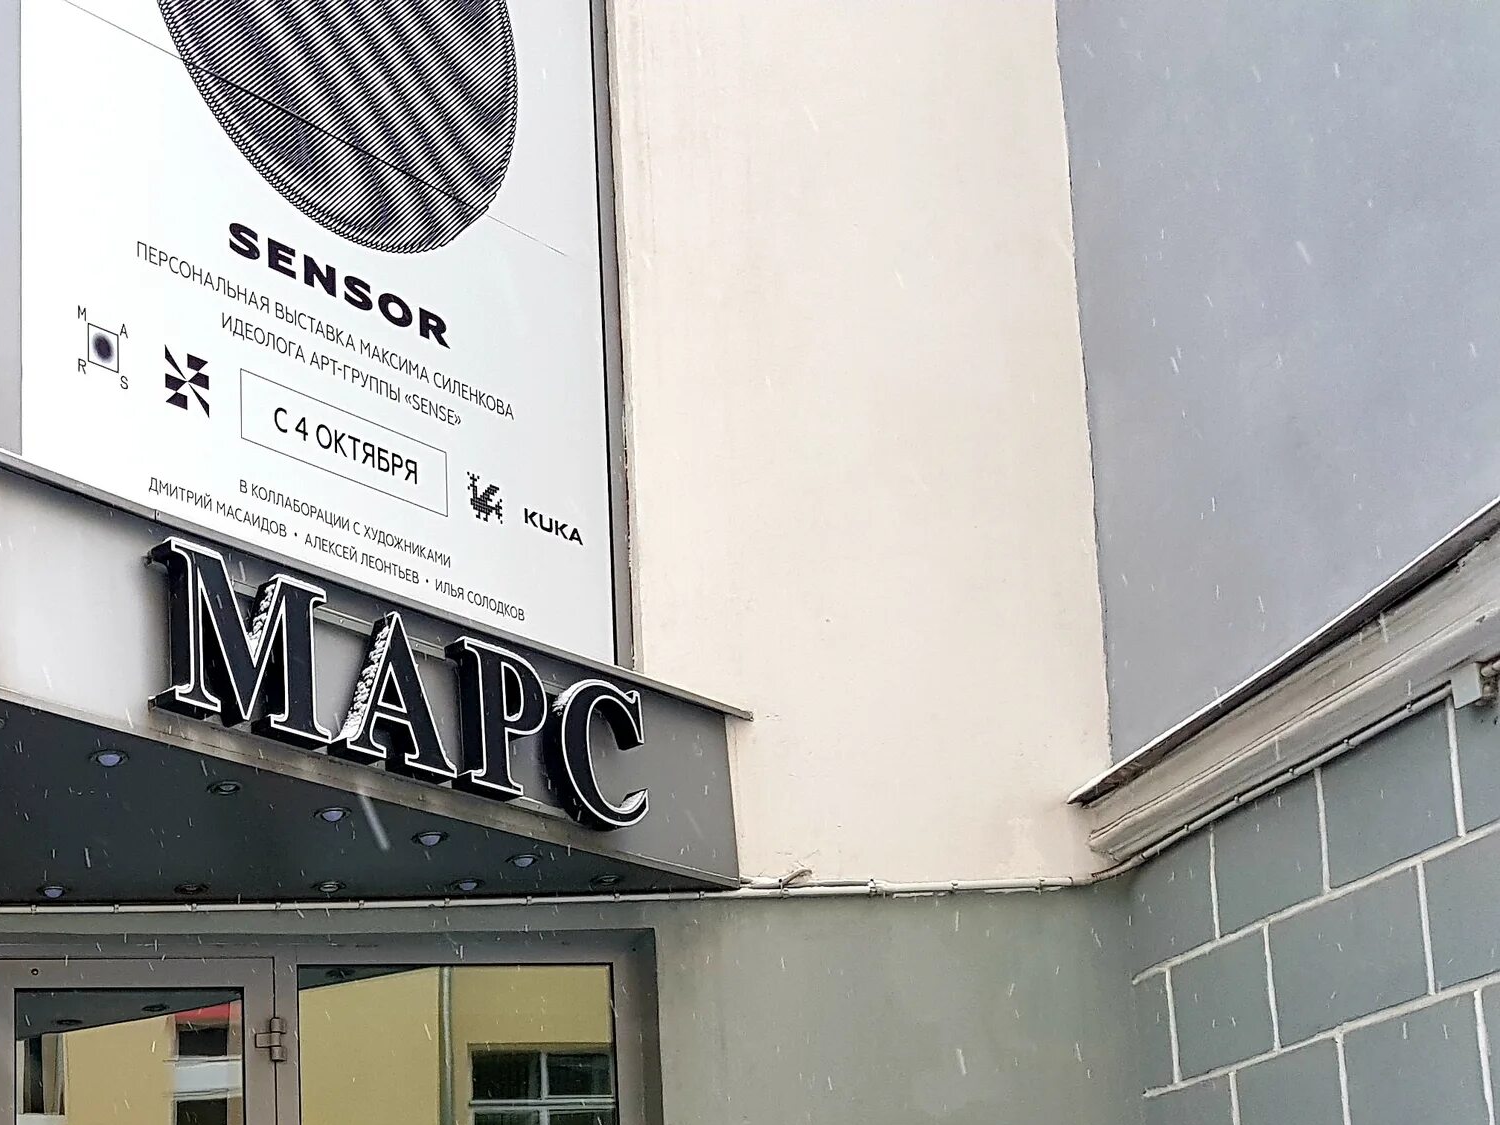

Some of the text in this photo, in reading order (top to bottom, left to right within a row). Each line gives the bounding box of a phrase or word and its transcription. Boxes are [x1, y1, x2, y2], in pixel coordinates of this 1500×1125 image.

[136, 241, 514, 420] ПЕРСОНАЛЬНАЯ ВЫСТАВКА МАКСИМА СИЛЕНКОВА
[229, 223, 451, 349] SENSOR
[221, 313, 462, 427] ИДЕОЛОГА АРТ-ГРУППЫ «SENSE»
[274, 407, 418, 485] С 4 ОКТЯБРЯ
[149, 477, 525, 622] ДМИТРИЙ МАСАИДОВ АЛЕКСЕЙ ЛЕОНТЬЕВ ИЛЬЯ СОЛОДКОВ
[239, 479, 248, 494] В
[251, 482, 350, 533] КОЛЛАБОРАЦИИ
[363, 521, 451, 568] ХУДОЖНИКАМИ
[524, 508, 583, 545] KUKA
[155, 537, 649, 830] МАРС
